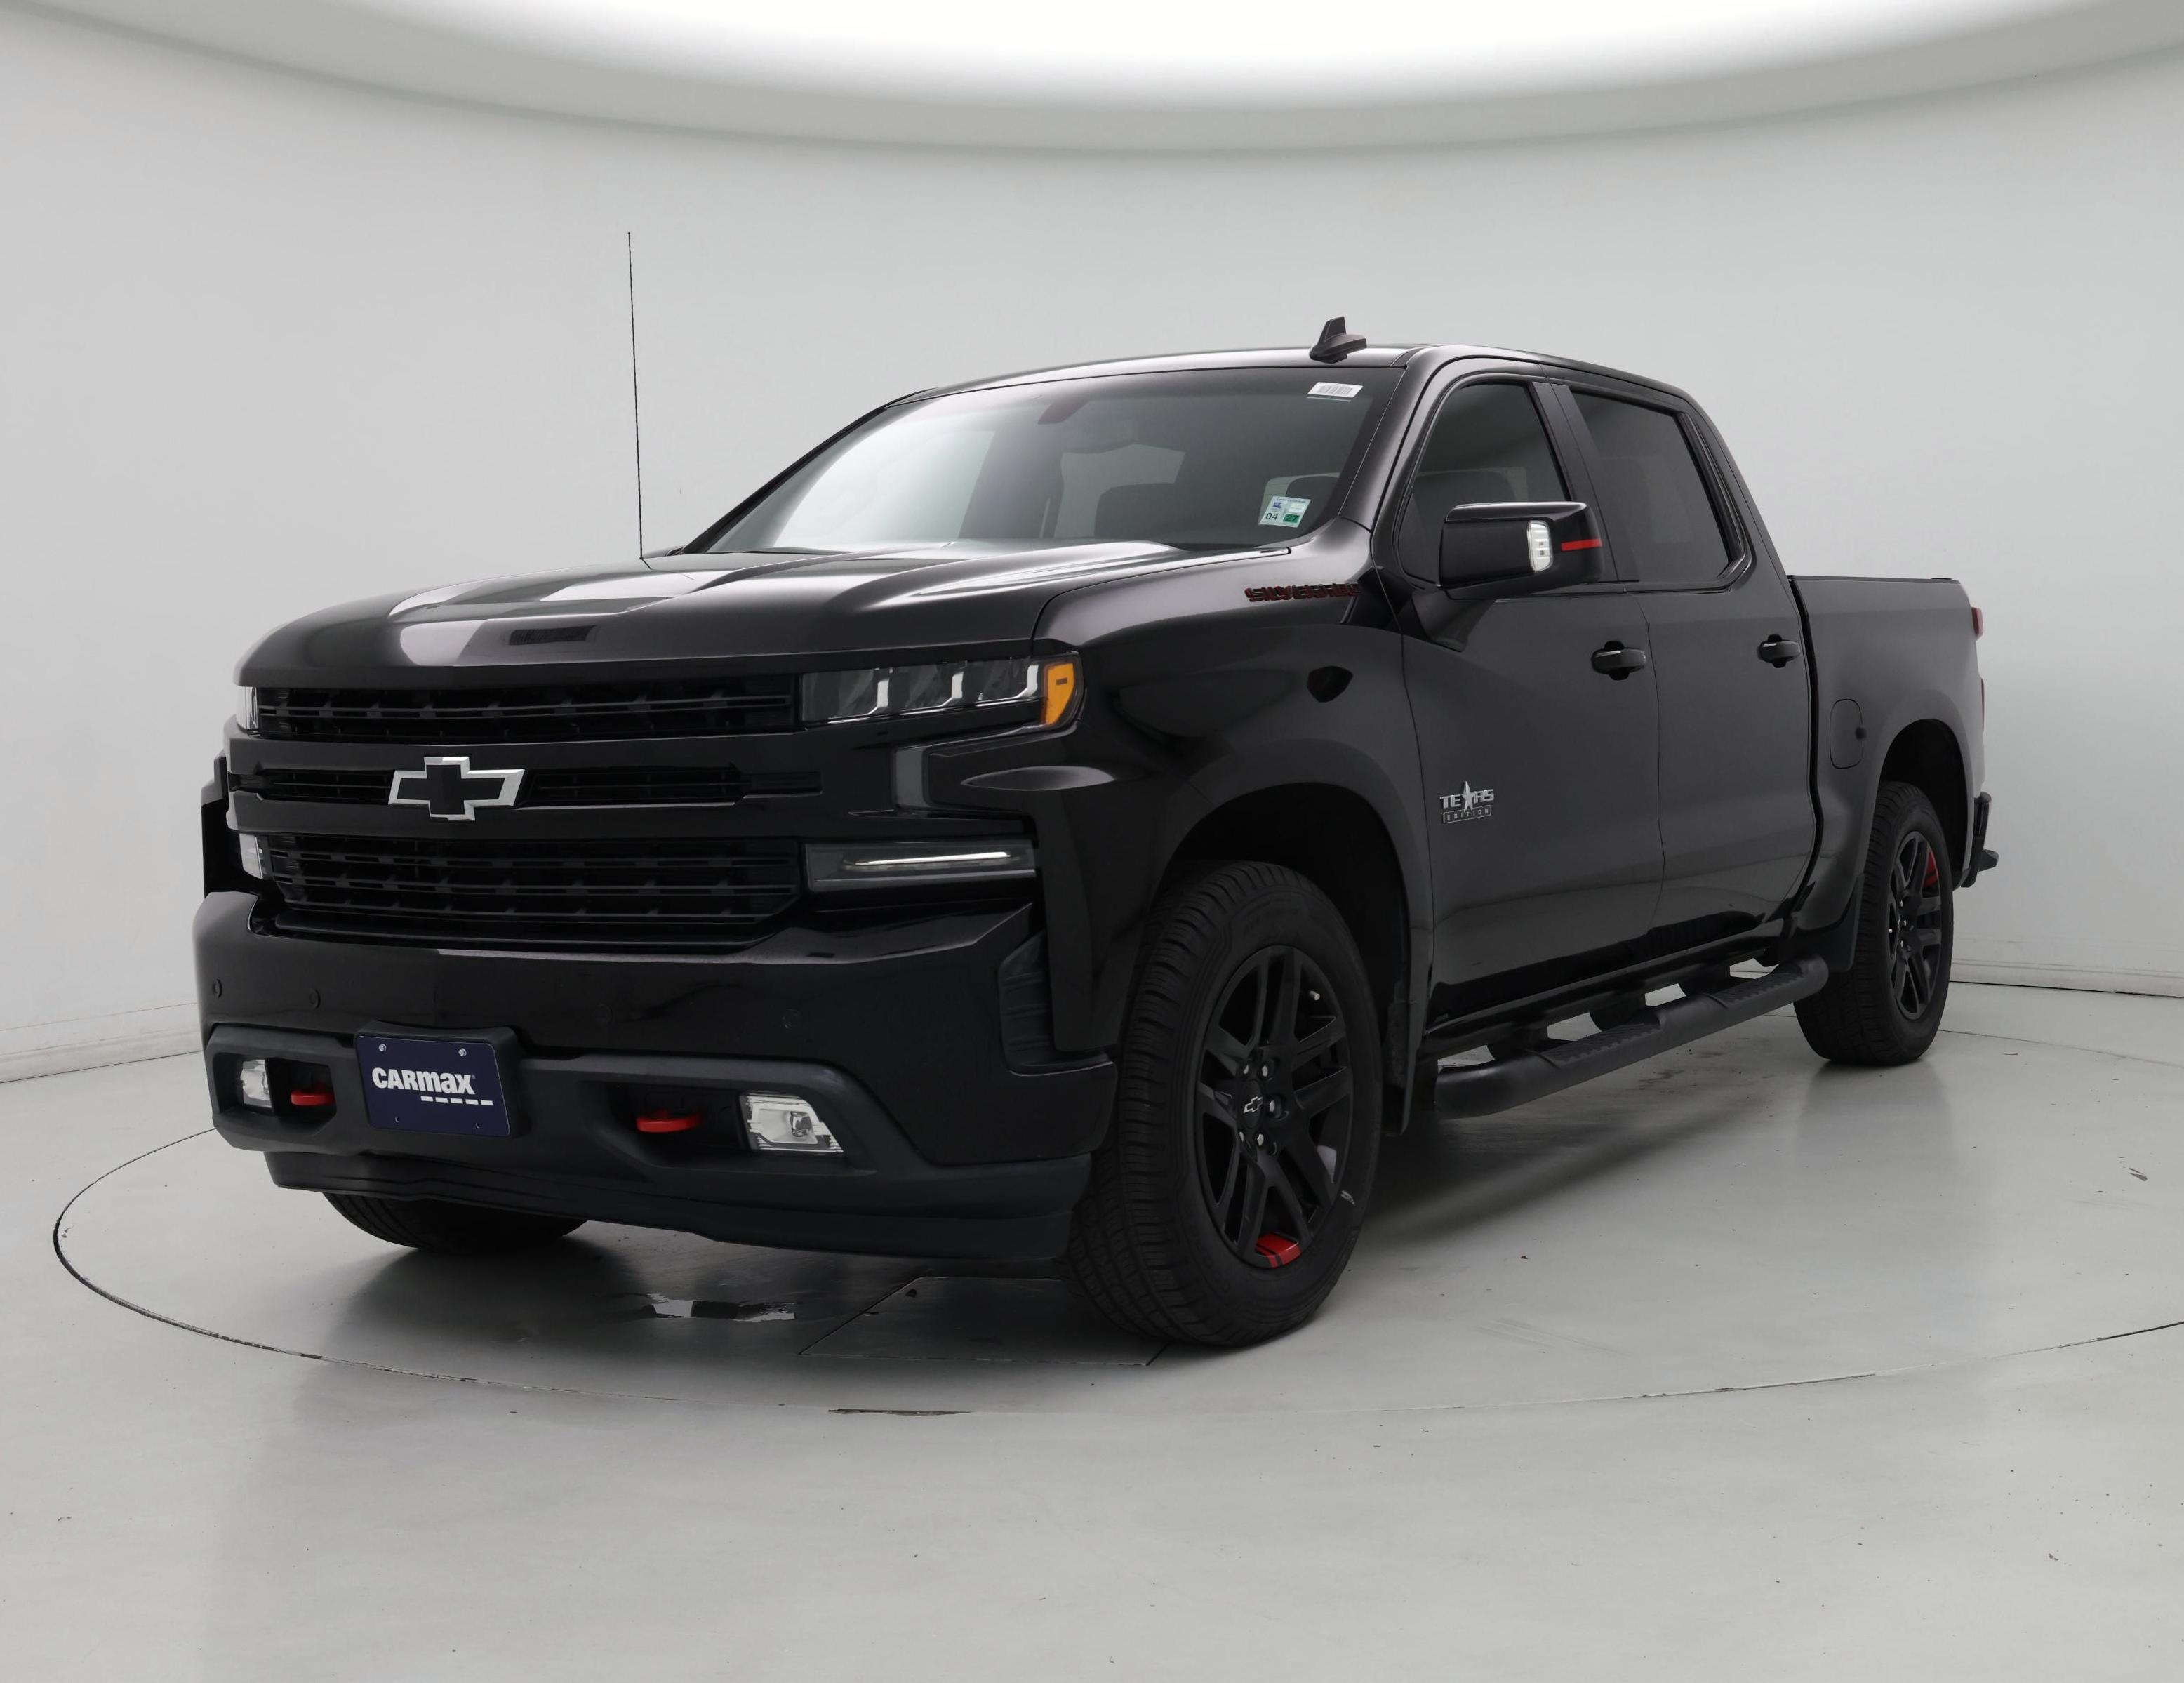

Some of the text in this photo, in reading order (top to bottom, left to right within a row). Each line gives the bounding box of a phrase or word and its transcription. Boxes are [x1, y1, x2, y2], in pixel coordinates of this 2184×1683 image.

[1265, 512, 1279, 521] 04
[1439, 781, 1494, 811] TEXAS
[1447, 808, 1489, 820] EDITION
